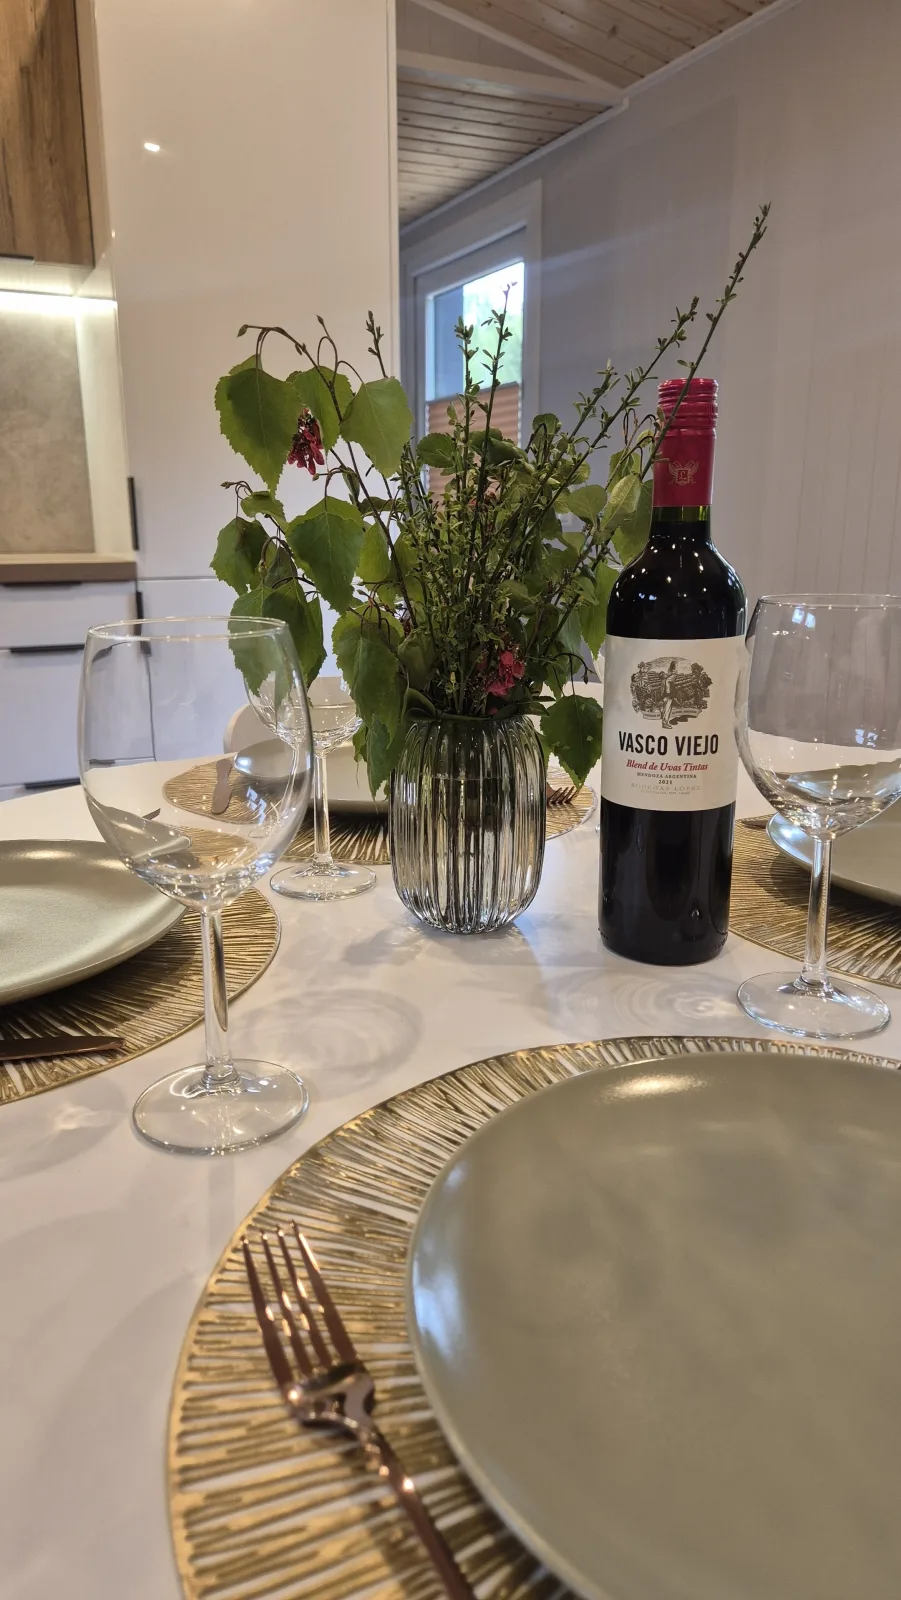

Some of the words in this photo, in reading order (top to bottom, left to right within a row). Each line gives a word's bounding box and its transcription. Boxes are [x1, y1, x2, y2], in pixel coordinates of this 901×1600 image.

[618, 730, 668, 756] VASCO
[675, 733, 719, 756] VIEJO
[626, 759, 647, 770] Blend
[648, 762, 658, 771] de
[660, 762, 681, 772] Uvas
[683, 762, 708, 772] Tintas
[636, 771, 663, 779] MENDOZA
